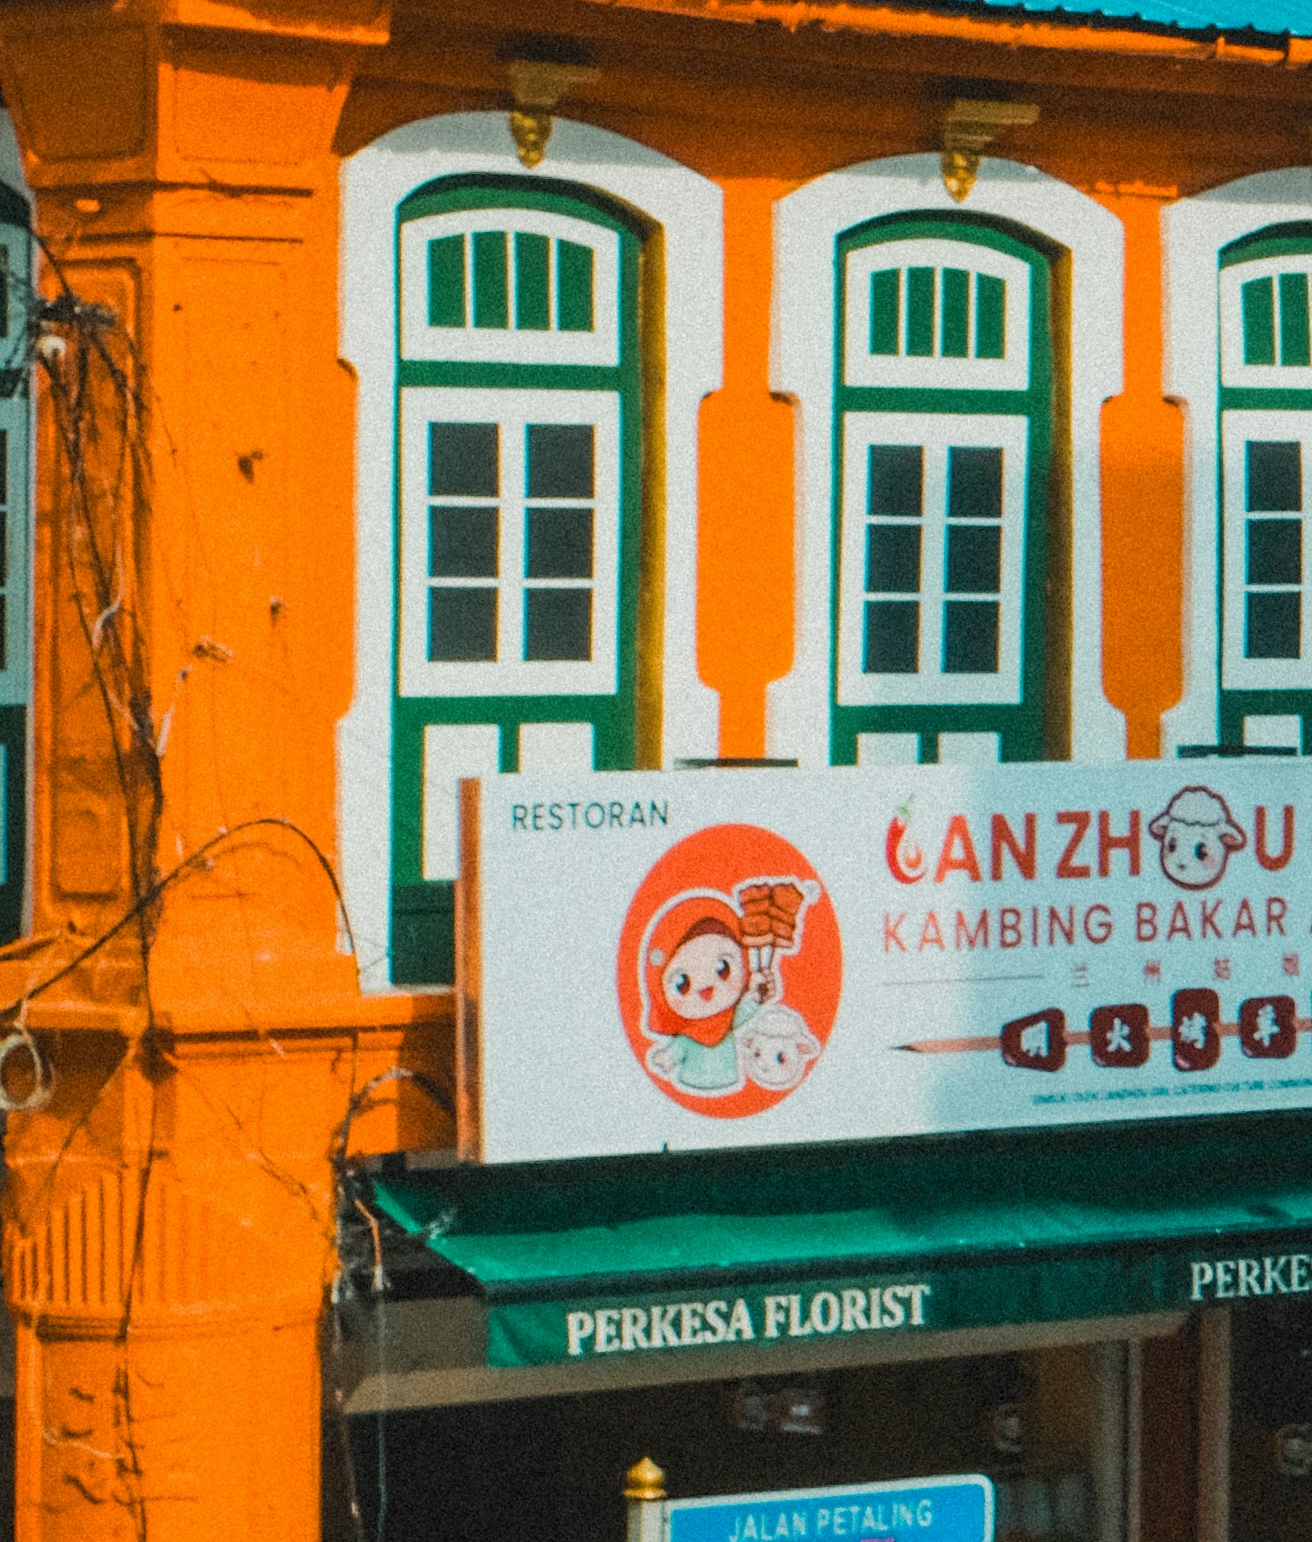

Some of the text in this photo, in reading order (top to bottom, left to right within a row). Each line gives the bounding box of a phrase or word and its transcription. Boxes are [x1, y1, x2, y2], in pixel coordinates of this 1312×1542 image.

[511, 799, 669, 831] RESTORAN
[883, 903, 1114, 953] KAMBING
[1135, 896, 1289, 944] BAKAR
[566, 1284, 931, 1356] PERKESA FLORIST
[817, 1498, 933, 1536] PETALING
